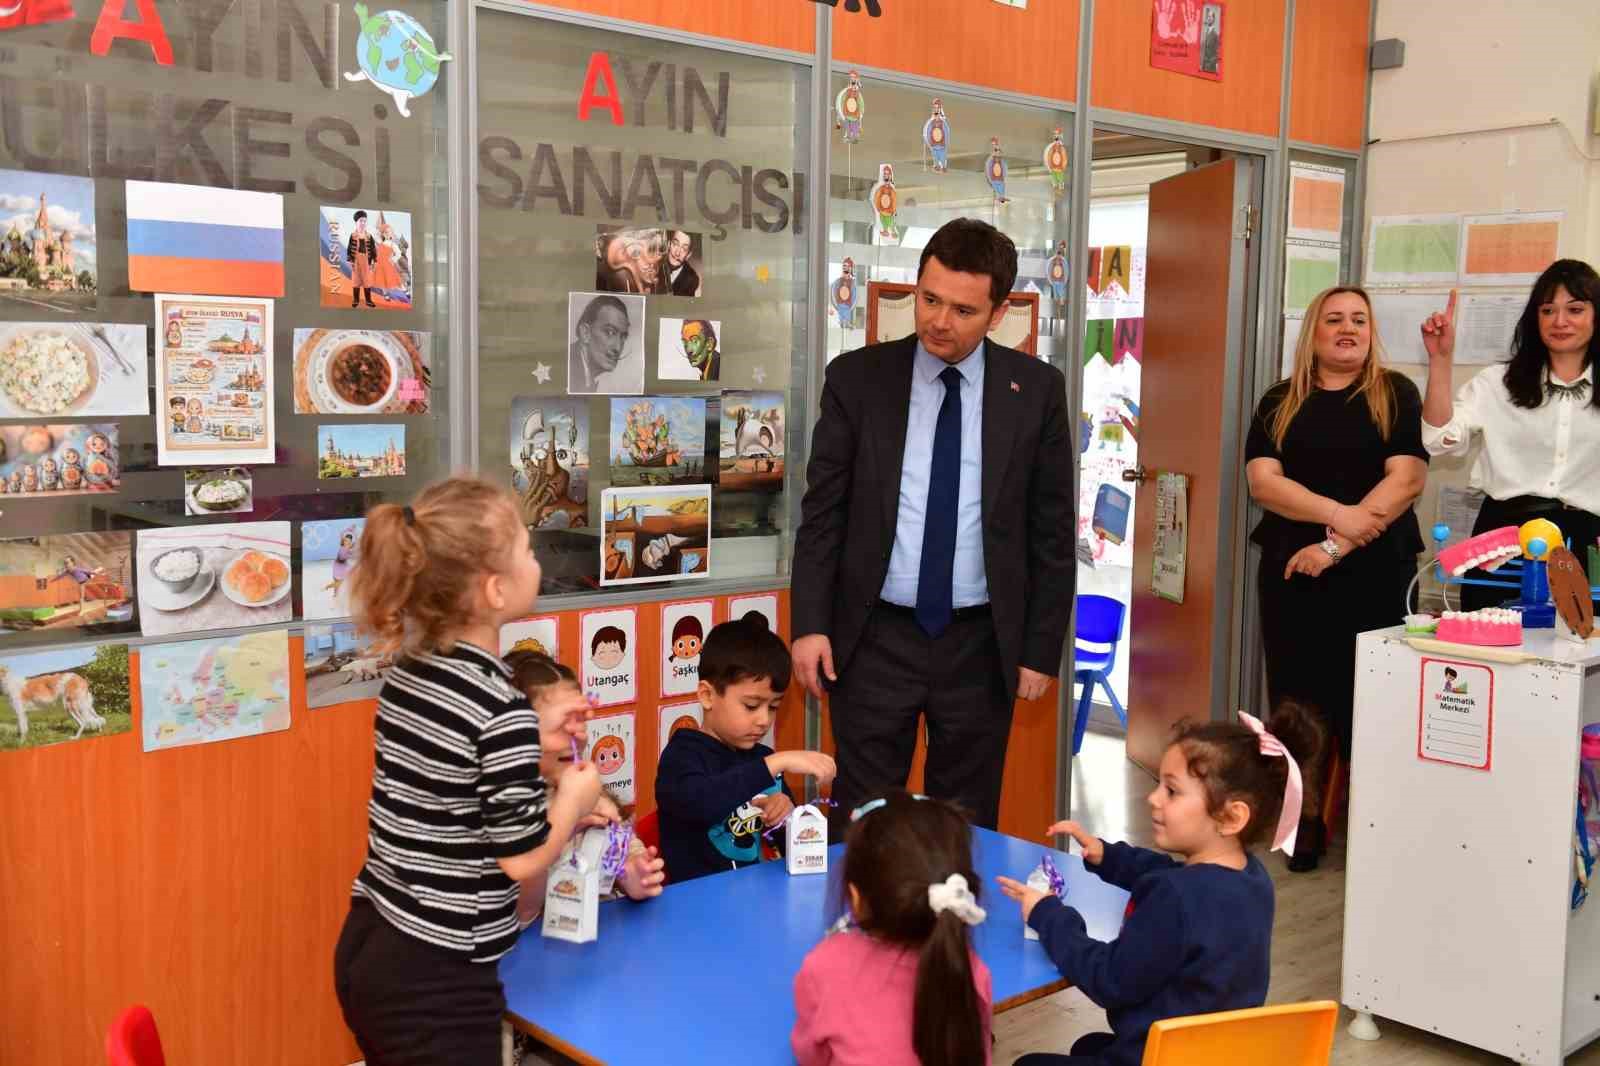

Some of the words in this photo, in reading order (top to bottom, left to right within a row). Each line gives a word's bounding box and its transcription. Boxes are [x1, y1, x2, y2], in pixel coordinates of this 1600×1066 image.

[577, 51, 730, 138] AYIN
[328, 222, 341, 295] RUSSIAN
[672, 663, 700, 678] Şaşkı
[587, 673, 630, 687] Utangaç
[1434, 693, 1475, 706] Matematik
[1439, 702, 1470, 713] Merkezi
